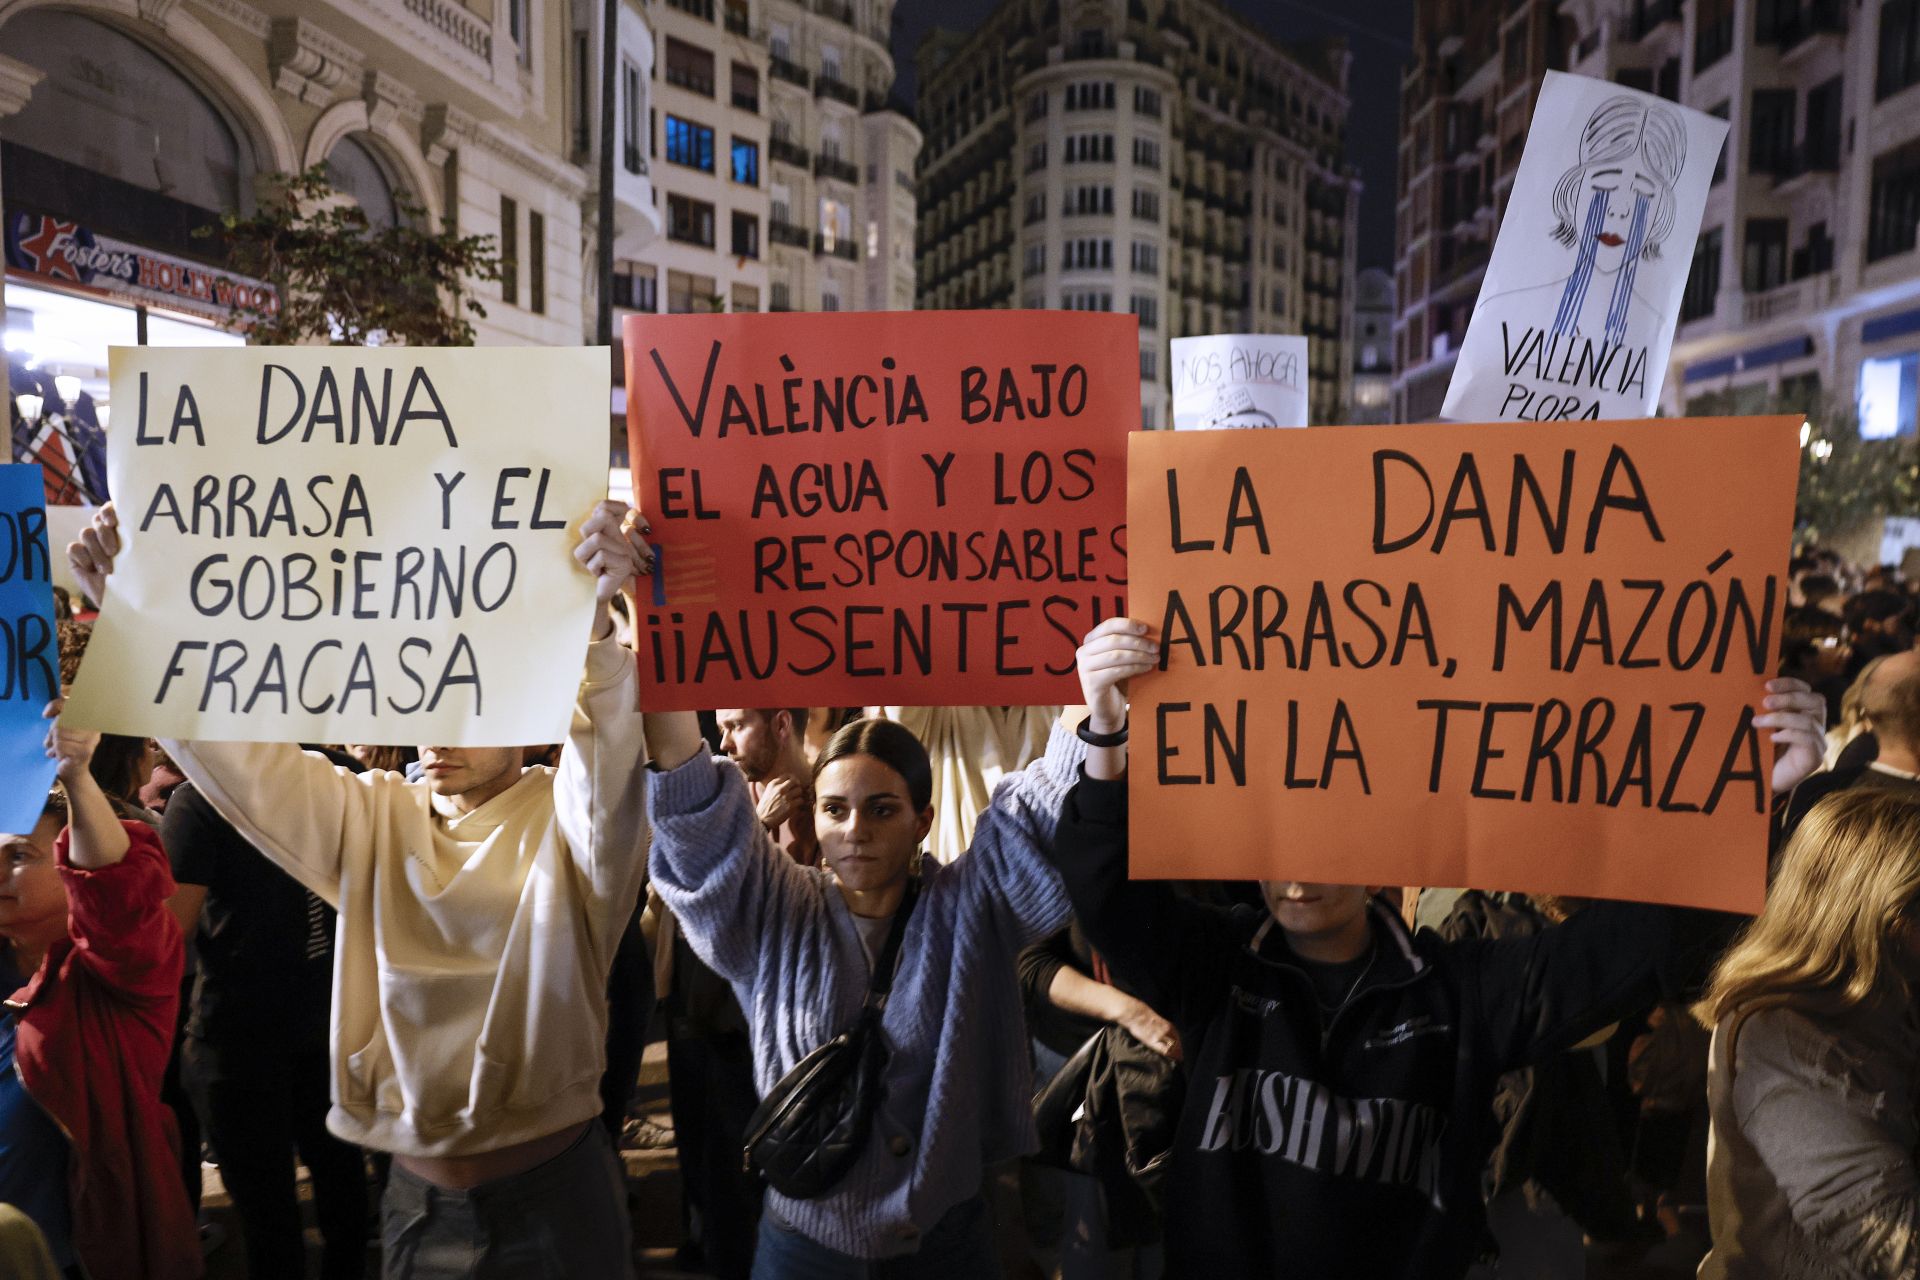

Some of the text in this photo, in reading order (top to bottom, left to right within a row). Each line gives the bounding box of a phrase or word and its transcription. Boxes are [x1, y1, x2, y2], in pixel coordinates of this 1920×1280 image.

[46, 232, 134, 279] Foster's
[136, 256, 281, 317] HOLLYWOOD
[136, 363, 459, 449] LA DANA
[961, 363, 1088, 425] BAJO
[1181, 347, 1298, 392] NOS AHOGA
[139, 467, 567, 539] ARRASA Y EL
[658, 448, 1096, 521] EL AGUA Y LOS
[1167, 443, 1666, 556] LA DANA
[753, 525, 1127, 594] RESPONSABLES
[647, 594, 1125, 684] ¡¡AUSENTES
[1158, 550, 1777, 679] ARRASA, MAZÓN
[153, 633, 482, 717] FRACASA
[1156, 696, 1766, 816] EN LA TERRAZA
